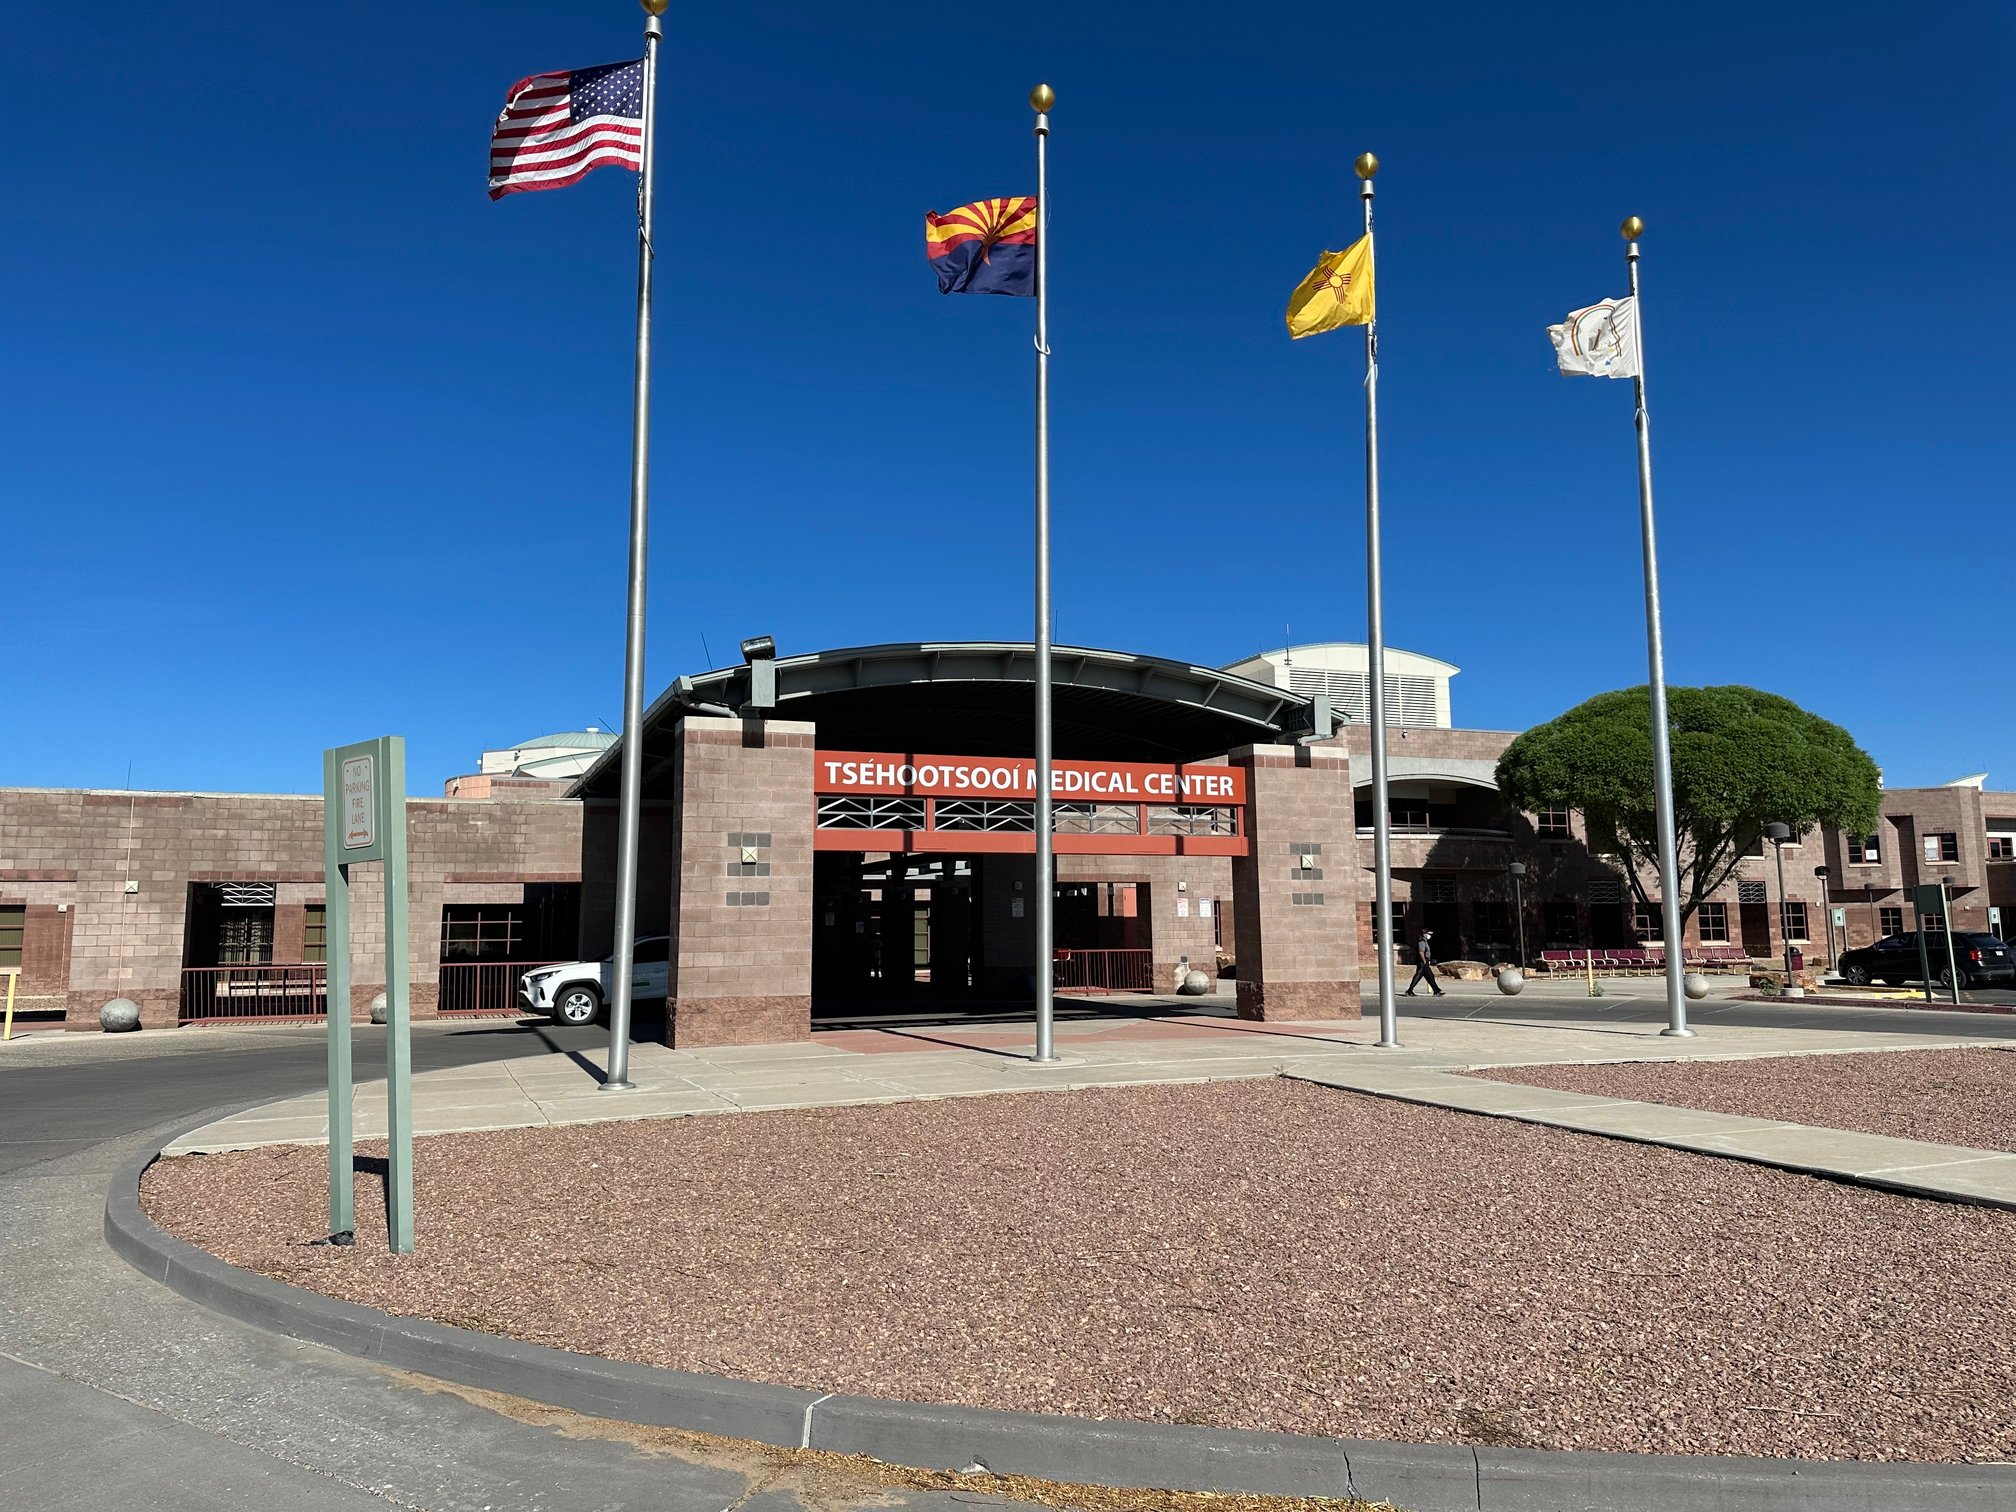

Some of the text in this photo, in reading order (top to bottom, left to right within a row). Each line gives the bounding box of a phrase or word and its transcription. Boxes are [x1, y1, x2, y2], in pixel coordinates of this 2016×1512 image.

[352, 765, 361, 776] NO
[824, 758, 1021, 790] TSÉHOOTSOOÍ
[1144, 773, 1234, 797] CENTER
[345, 780, 369, 794] PARKING
[352, 797, 364, 808] FIRE
[352, 812, 365, 824] LANE
